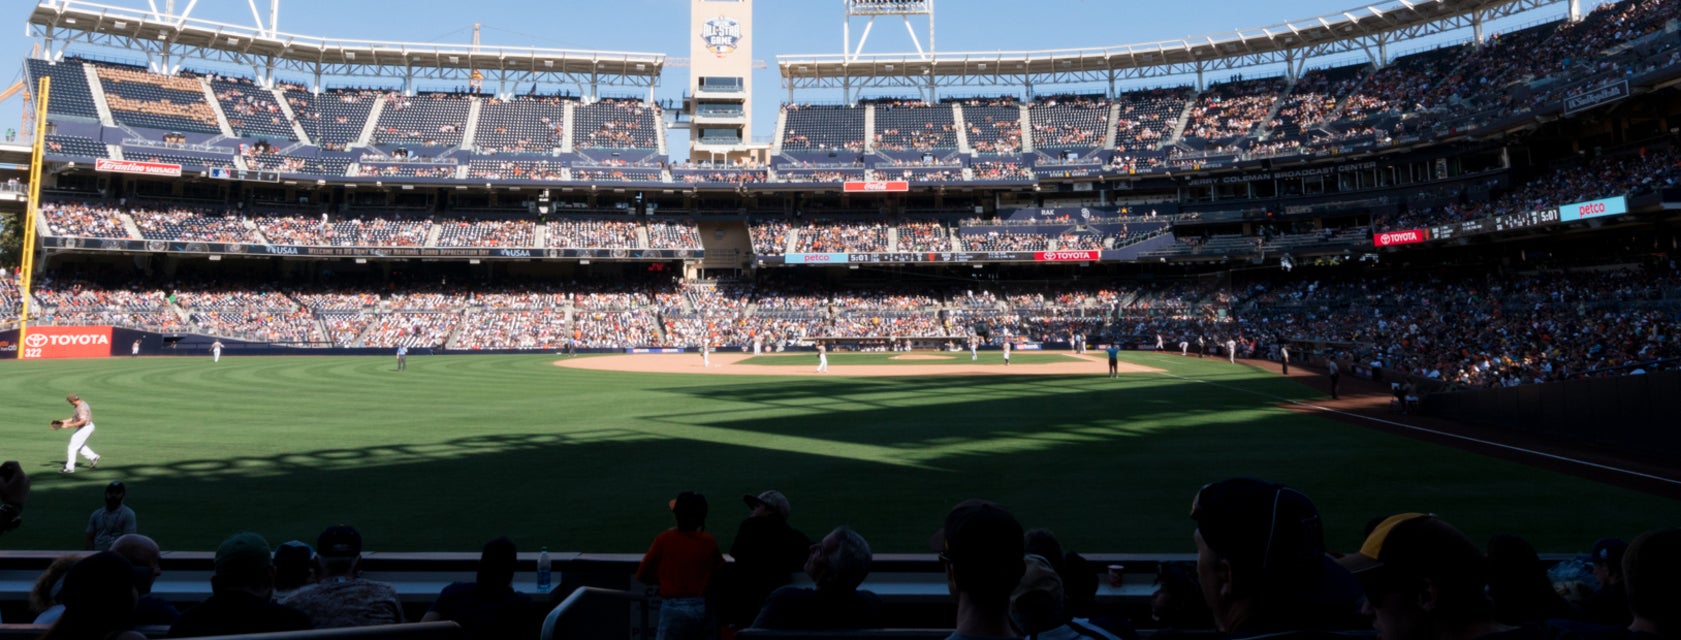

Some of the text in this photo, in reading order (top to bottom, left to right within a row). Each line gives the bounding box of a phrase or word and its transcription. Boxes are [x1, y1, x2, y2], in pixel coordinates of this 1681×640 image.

[710, 35, 733, 45] GAME
[146, 166, 180, 174] SAUSAGES
[1188, 161, 1377, 186] JERRY COLEMAN BROADCAST CENTER
[1579, 202, 1605, 218] petco
[1541, 210, 1557, 222] 5:01
[1390, 232, 1417, 242] TOYOTA
[308, 247, 334, 255] WELCOME
[804, 253, 829, 262] petco
[50, 334, 108, 345] TOYOTA
[25, 348, 42, 357] 322
